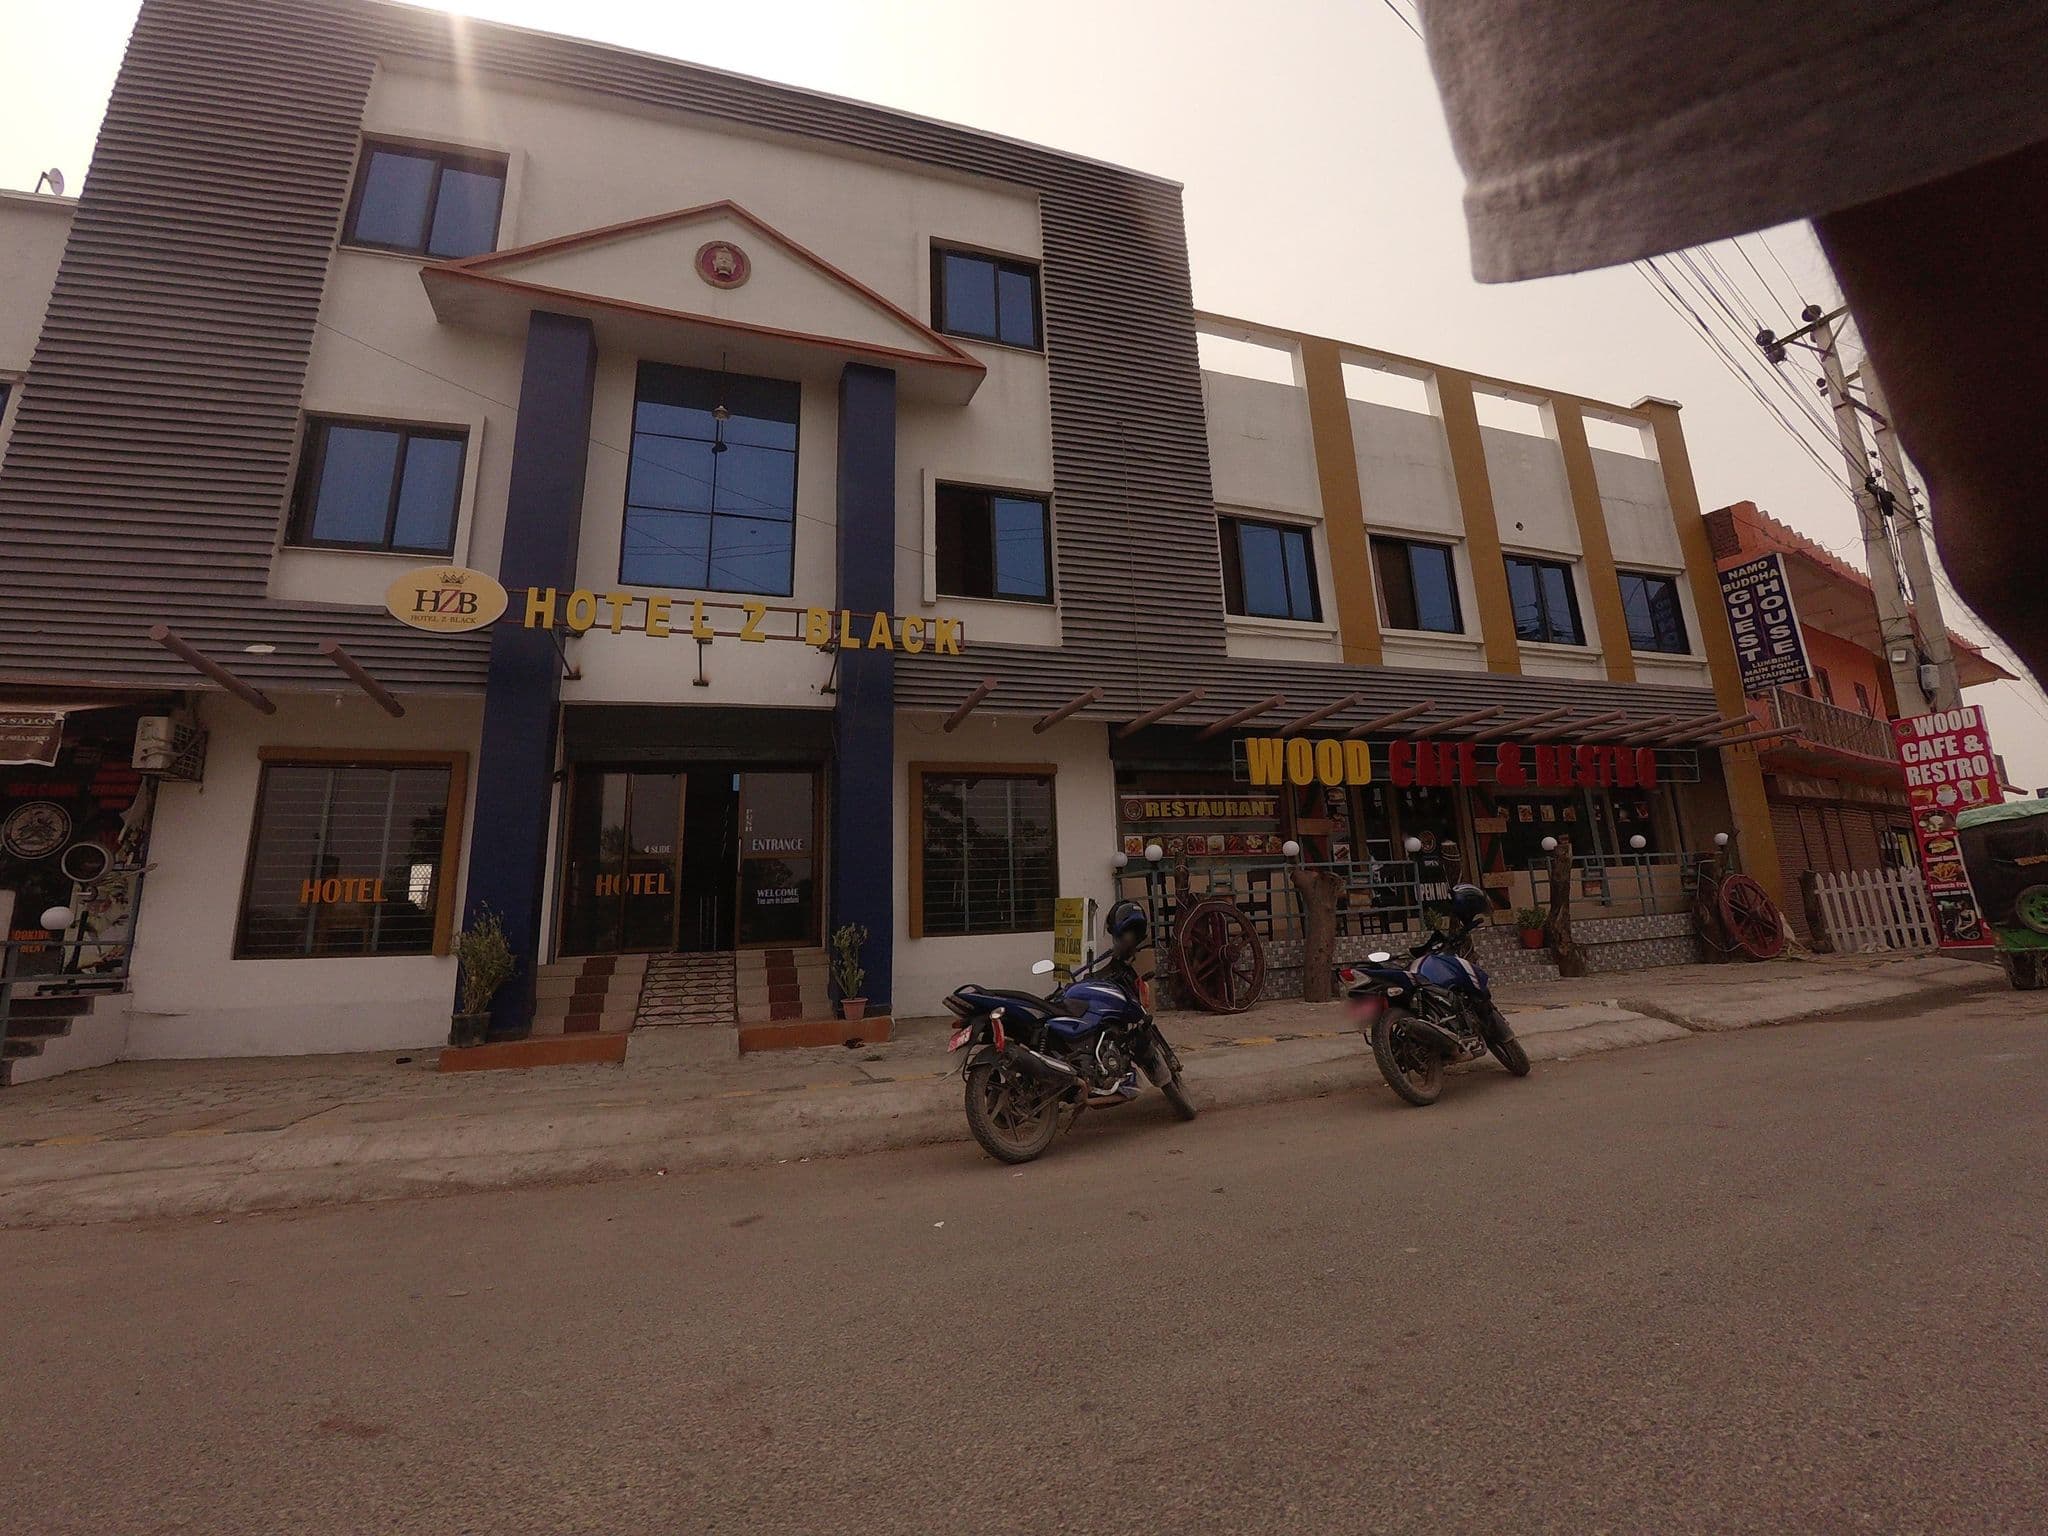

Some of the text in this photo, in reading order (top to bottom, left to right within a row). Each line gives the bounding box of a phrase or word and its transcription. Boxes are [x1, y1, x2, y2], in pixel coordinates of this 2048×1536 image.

[1722, 568, 1780, 593] BUDDHA
[1727, 560, 1768, 580] NAMO
[412, 589, 478, 614] HZB
[523, 586, 962, 655] HOTEL Z BLACK
[1728, 589, 1762, 662] GUEST
[1756, 579, 1796, 655] HOUSE
[1745, 659, 1800, 677] MAIN POINT
[1751, 655, 1791, 669] LUMBINI
[1744, 666, 1805, 684] RESTAURANT
[1912, 708, 1977, 737] WOOD
[1901, 734, 1984, 763] CAFE &
[1245, 736, 1373, 787] WOOD
[1388, 739, 1479, 788] CAFE
[1495, 741, 1528, 788] &
[1905, 754, 1990, 787] RESTRO
[1145, 800, 1276, 818] RESTAURANT
[650, 846, 672, 854] SLIDE
[752, 838, 804, 851] ENTRANCE
[300, 878, 388, 904] HOTEL
[594, 872, 672, 897] HOTEL
[756, 888, 800, 898] WELCOME
